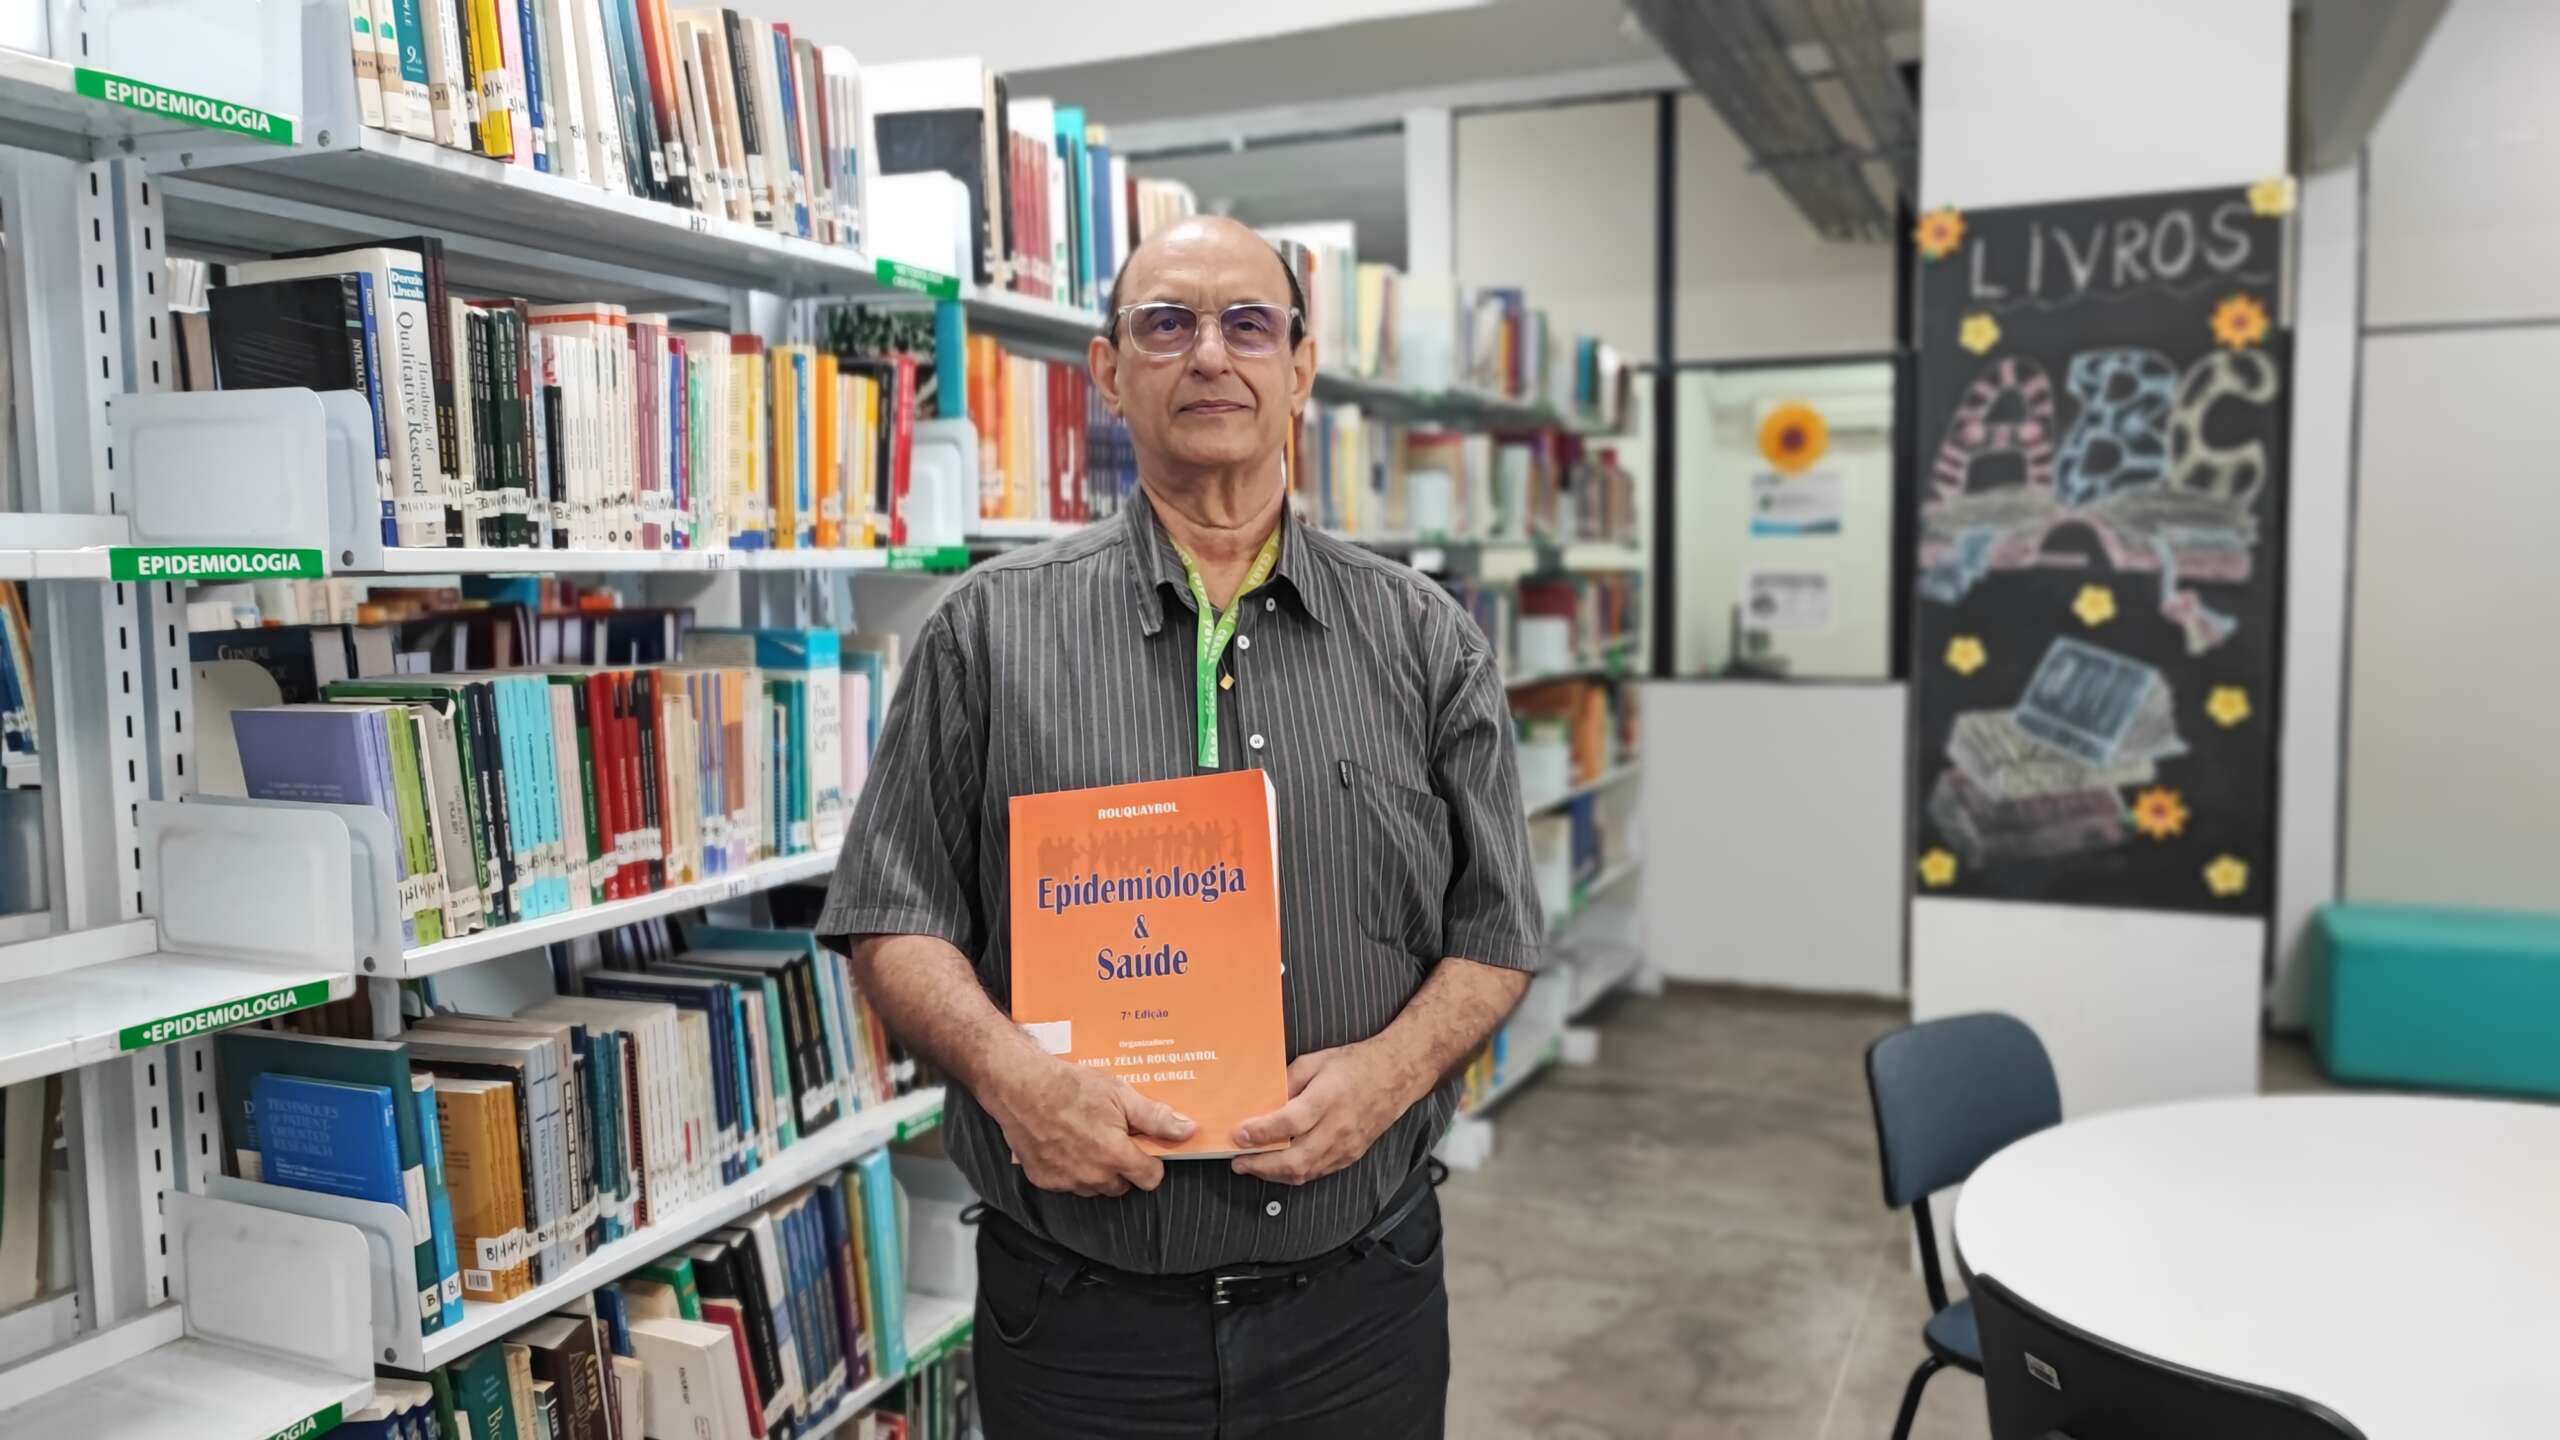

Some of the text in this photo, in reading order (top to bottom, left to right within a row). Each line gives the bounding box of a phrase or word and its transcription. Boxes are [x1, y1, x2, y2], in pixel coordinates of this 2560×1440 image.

[104, 79, 271, 134] EPIDEMIOLOGIA
[689, 214, 709, 232] H7
[1970, 204, 2251, 300] LIVROS
[391, 271, 424, 286] Denzin
[392, 285, 424, 299] Lincoln
[396, 311, 416, 416] Qualitative
[418, 361, 435, 453] Handbook of
[1931, 347, 2278, 506] ABC
[137, 553, 302, 577] EPIDEMIOLOGIA
[1098, 801, 1179, 820] ROUQUAYROL
[1037, 863, 1247, 915] Epidemiologia
[1133, 914, 1150, 939] &
[1097, 943, 1189, 981] Saúde
[1134, 1008, 1170, 1020] Edição
[1147, 1050, 1219, 1065] ROUQUAYROL
[1154, 1070, 1196, 1082] GURGEL
